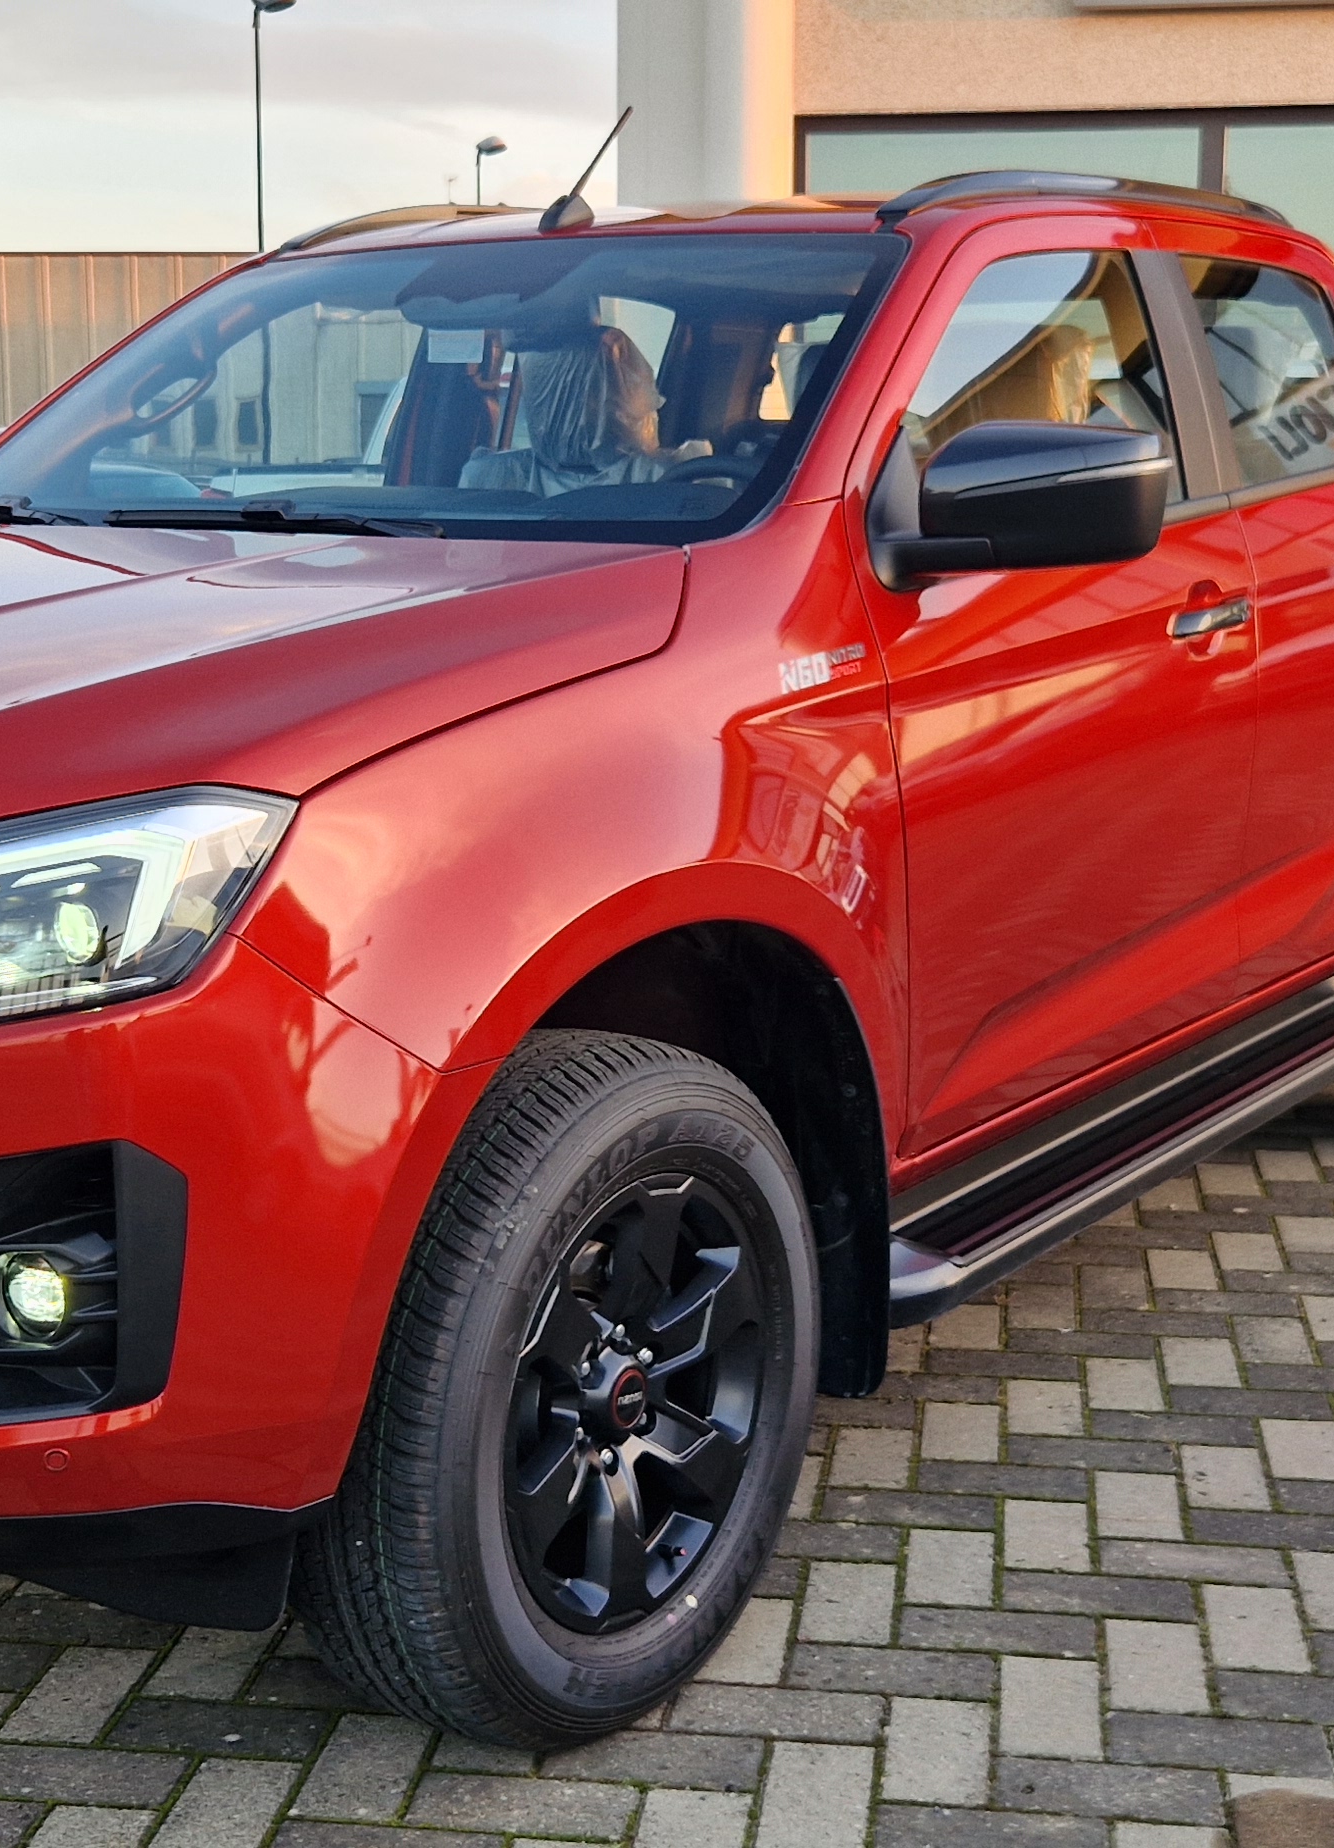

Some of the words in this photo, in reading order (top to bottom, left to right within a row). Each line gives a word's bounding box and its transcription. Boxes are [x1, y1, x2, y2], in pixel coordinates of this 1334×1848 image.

[827, 643, 866, 666] NITRO
[778, 651, 831, 695] N60
[830, 660, 862, 681] SPORT
